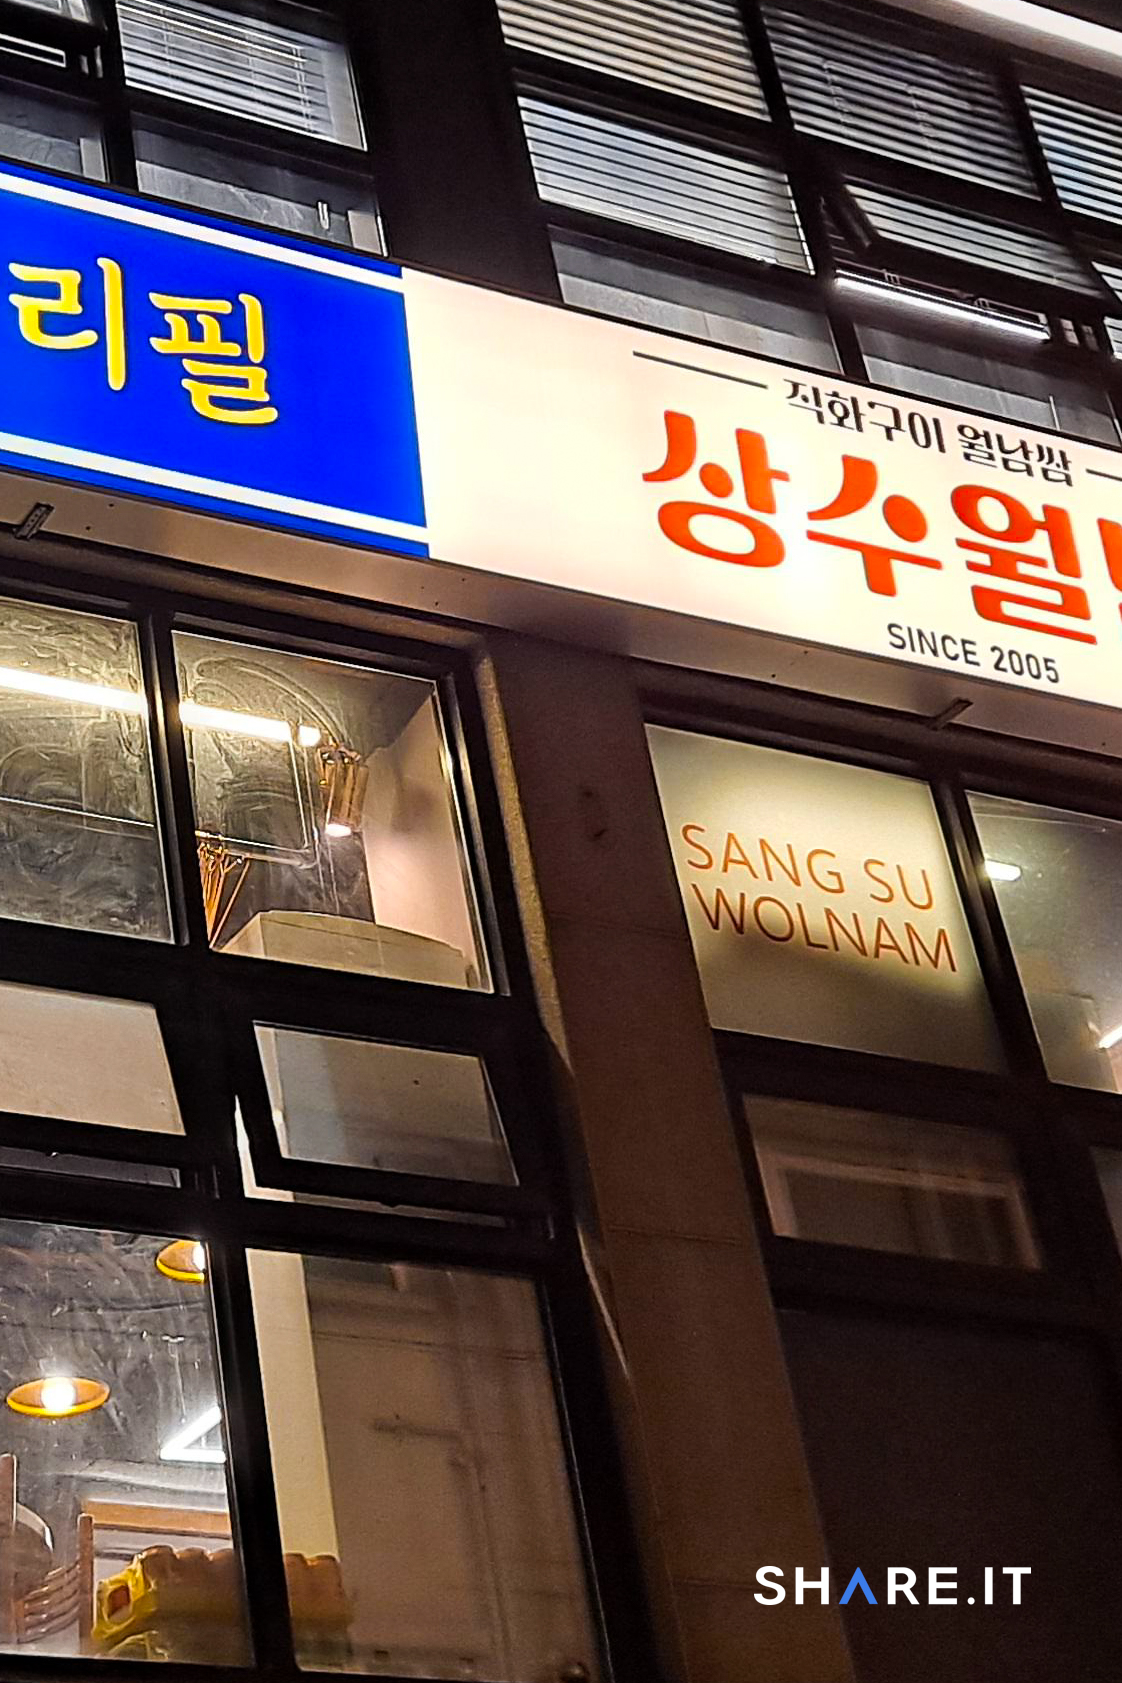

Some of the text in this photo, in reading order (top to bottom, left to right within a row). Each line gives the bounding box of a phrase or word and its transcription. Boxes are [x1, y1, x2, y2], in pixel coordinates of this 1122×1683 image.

[783, 378, 1074, 487] 직화구이 월남쌈
[642, 410, 1122, 645] 상수월
[887, 623, 1060, 684] SINCE 2005
[680, 824, 934, 910] SANG SU
[692, 883, 957, 973] WOLNAM
